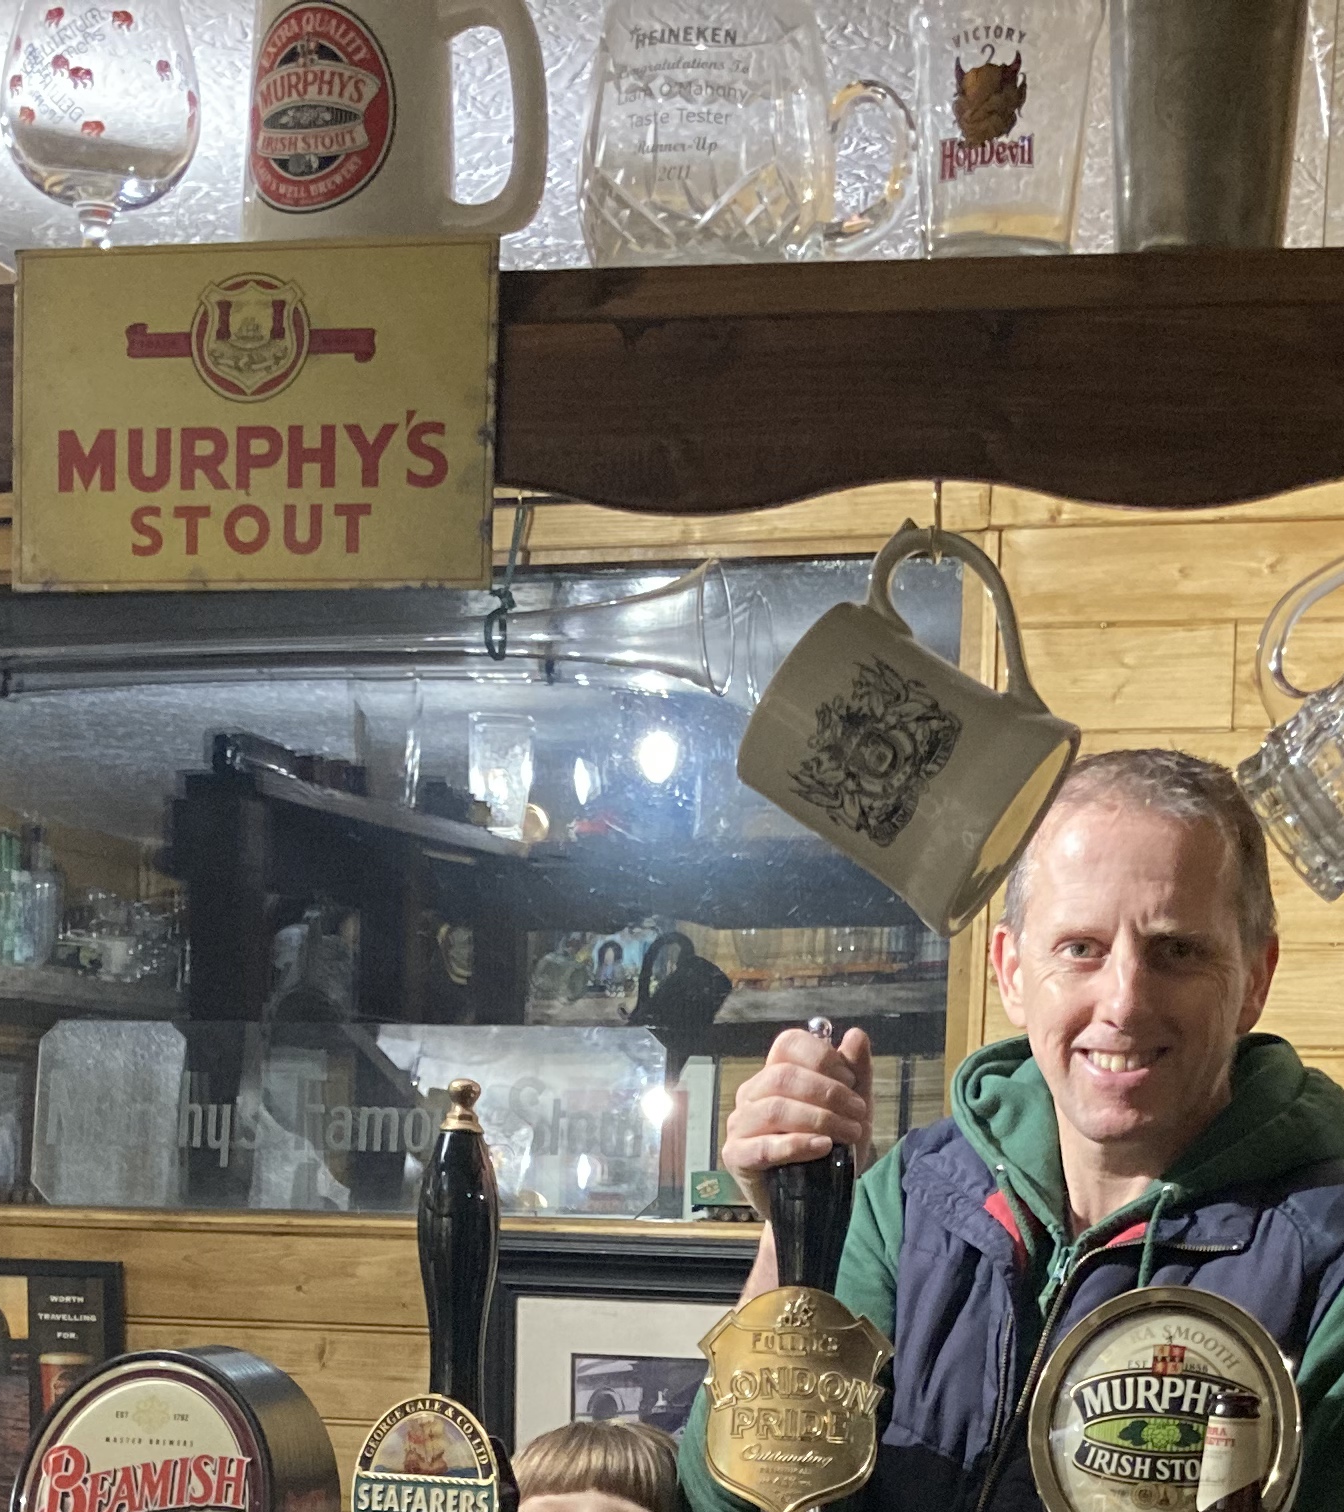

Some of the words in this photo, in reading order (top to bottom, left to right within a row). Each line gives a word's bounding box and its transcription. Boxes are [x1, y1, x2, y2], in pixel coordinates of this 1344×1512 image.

[635, 26, 737, 49] HEINEKEN
[952, 24, 1027, 48] VICTORY
[627, 110, 670, 129] Taste
[676, 107, 733, 125] Tester
[261, 133, 298, 153] IRISH
[301, 129, 357, 151] STOUT
[939, 133, 1035, 183] HopDevil
[57, 410, 449, 493] MURPHY'S
[130, 503, 372, 557] STOUT
[49, 1295, 84, 1303] WORTH
[38, 1313, 97, 1322] TRAVELLING
[1163, 1324, 1241, 1369] SMOOTH
[711, 1365, 885, 1416] LONDON
[364, 1408, 404, 1458] GEORGE
[406, 1400, 442, 1412] GALE
[444, 1405, 455, 1417] &
[472, 1438, 489, 1465] LTD
[730, 1407, 854, 1444] PRIDE
[105, 1436, 143, 1445] MASTER
[149, 1438, 195, 1448] BREWERS
[739, 1443, 834, 1469] Outstanding
[1083, 1446, 1152, 1481] IRISH
[1155, 1456, 1201, 1481] STO
